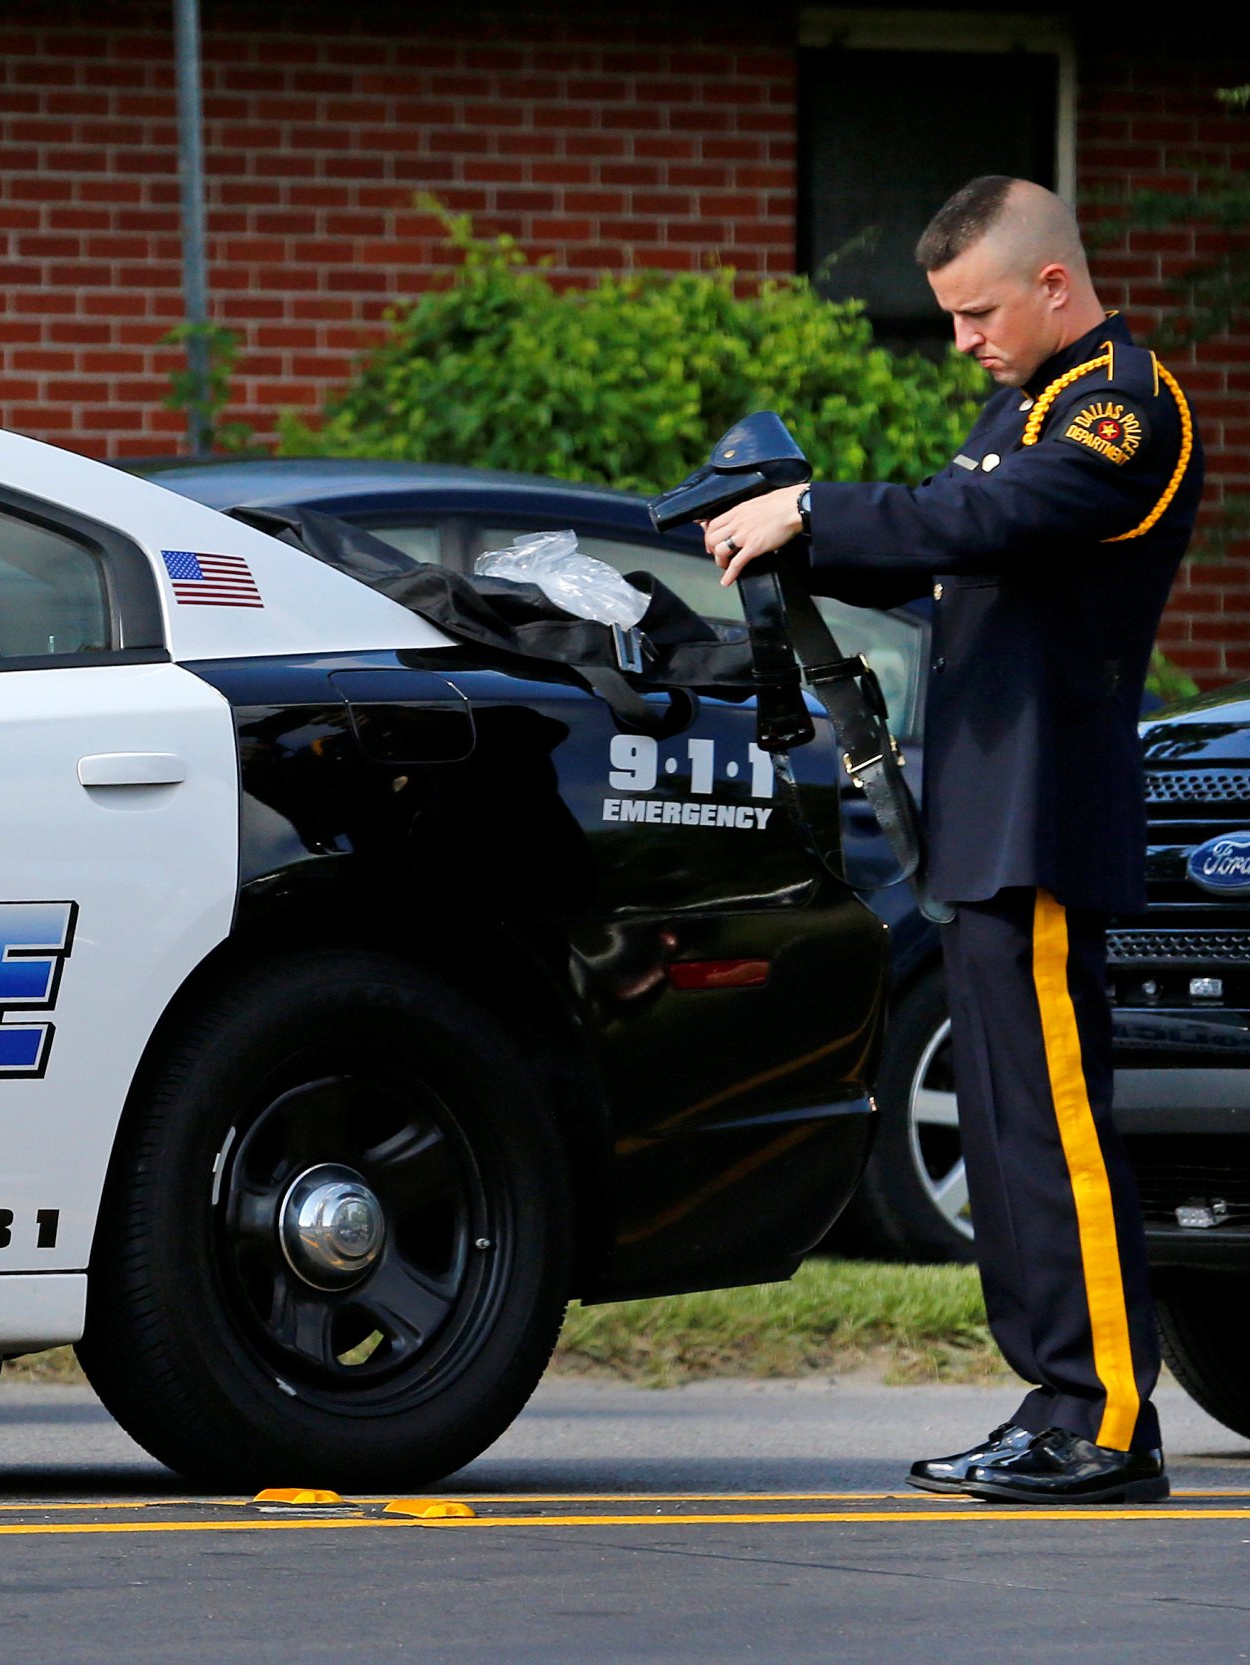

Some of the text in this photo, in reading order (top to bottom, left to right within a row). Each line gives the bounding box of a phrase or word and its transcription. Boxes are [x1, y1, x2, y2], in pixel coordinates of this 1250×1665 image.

[1073, 401, 1124, 428] DALLAS
[1065, 424, 1131, 465] DEPARTMENT
[602, 798, 773, 830] EMERGENCY
